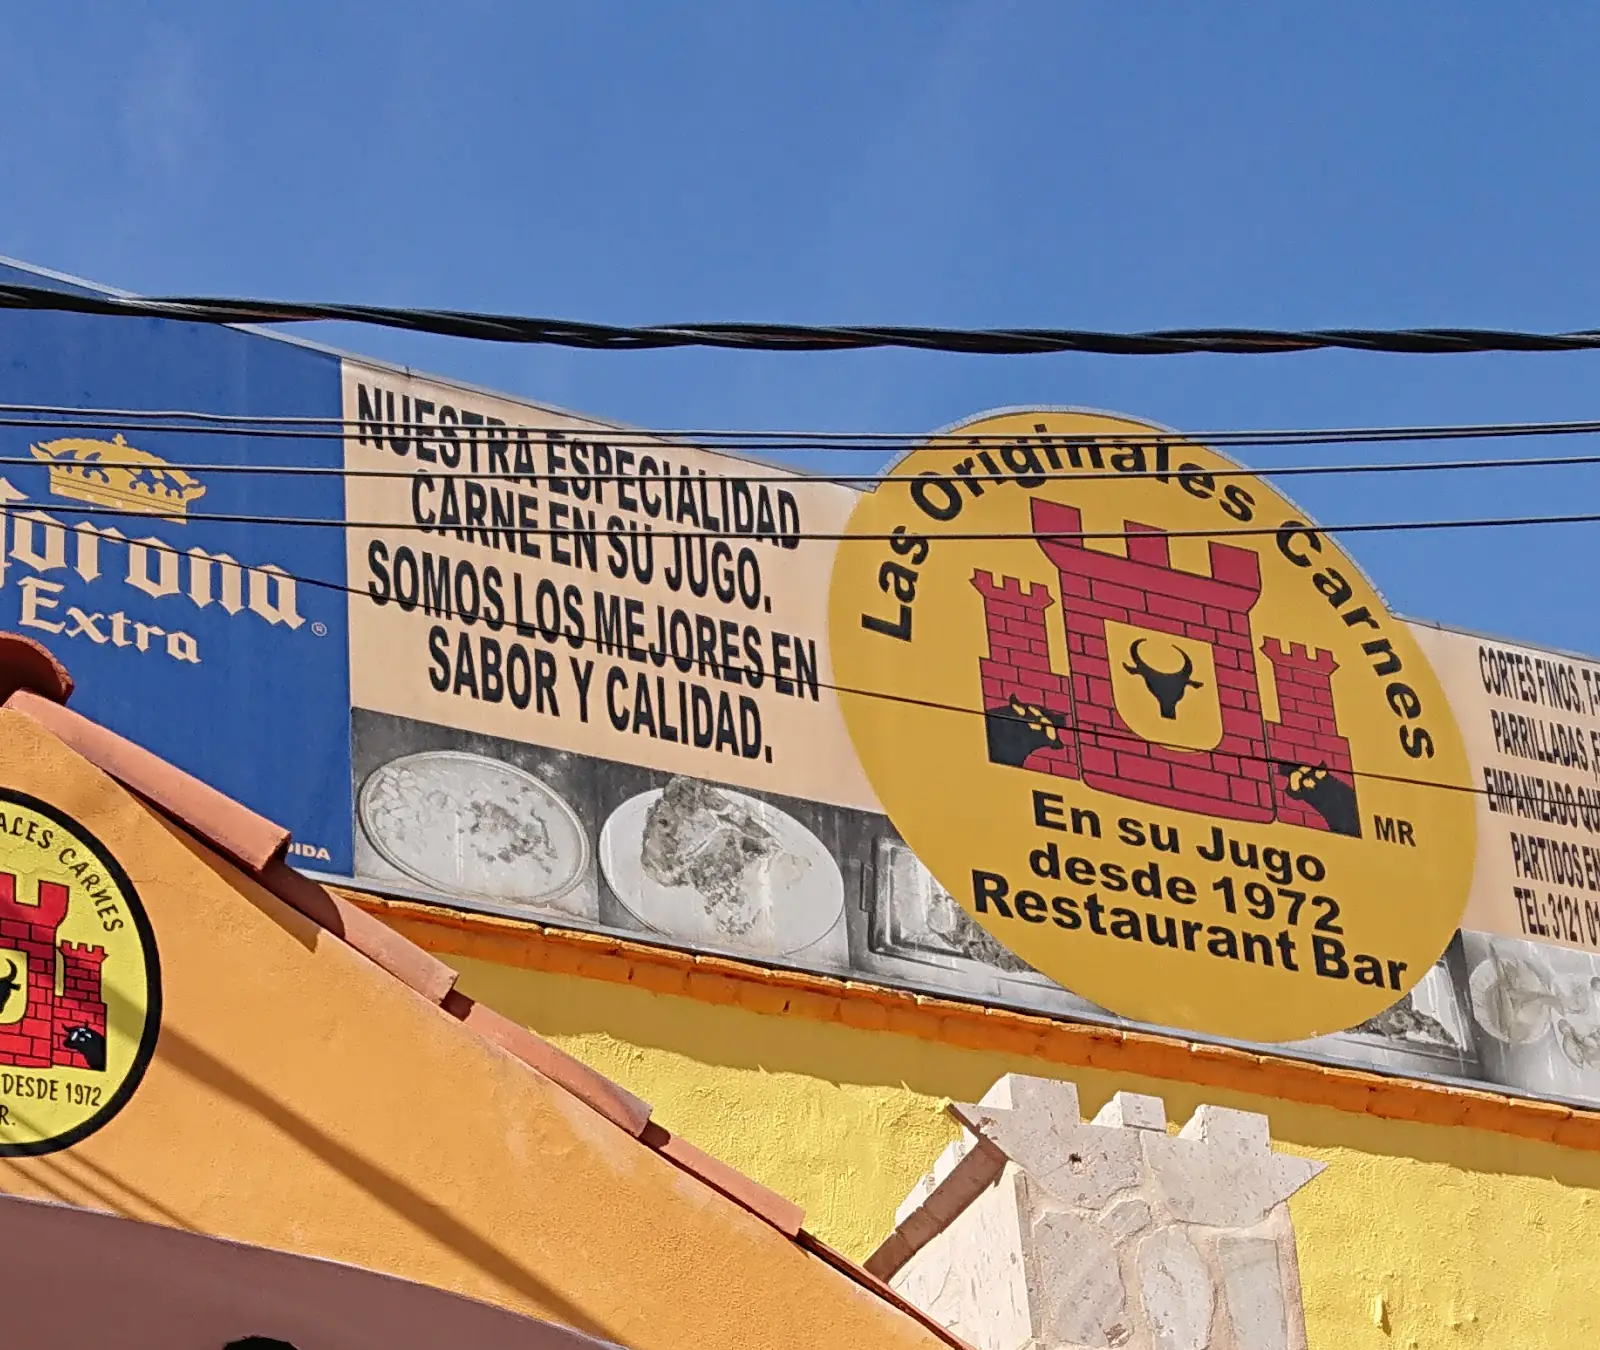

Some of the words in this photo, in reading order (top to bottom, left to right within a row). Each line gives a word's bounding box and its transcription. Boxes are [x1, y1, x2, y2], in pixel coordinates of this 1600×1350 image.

[357, 383, 537, 488] NUESTRA
[546, 430, 802, 551] ESPECIALIDAD
[411, 469, 541, 559] CARNE
[549, 502, 598, 572] EN
[607, 514, 654, 585] SU
[664, 526, 773, 613] JUGO.
[16, 574, 203, 665] Extra
[367, 540, 505, 633] SOMOS
[513, 572, 587, 650] LOS
[594, 591, 765, 690] MEJORES
[771, 631, 820, 703] EN
[860, 524, 930, 643] Las
[908, 423, 1258, 523] Originales
[1274, 518, 1436, 762] Carnes
[427, 625, 561, 718] SABOR
[568, 656, 595, 724] Y
[606, 666, 774, 764] CALIDAD.
[1478, 645, 1538, 705] CORTES
[1490, 708, 1589, 772] PARRILLADAS
[1031, 788, 1102, 840] En
[1116, 814, 1180, 855] su
[1195, 826, 1327, 885] Jugo
[1373, 814, 1418, 848] MR
[1482, 766, 1578, 829] EMPANIZADO
[58, 846, 126, 934] CARNES
[1028, 840, 1199, 907] desde
[1211, 874, 1346, 936] 1972
[1510, 831, 1585, 890] PARTIDOS
[970, 867, 1302, 974] Restaurant
[1311, 933, 1409, 992] Bar
[1547, 892, 1585, 945] 3121
[0, 1073, 59, 1102] DESDE
[64, 1081, 103, 1108] 1972
